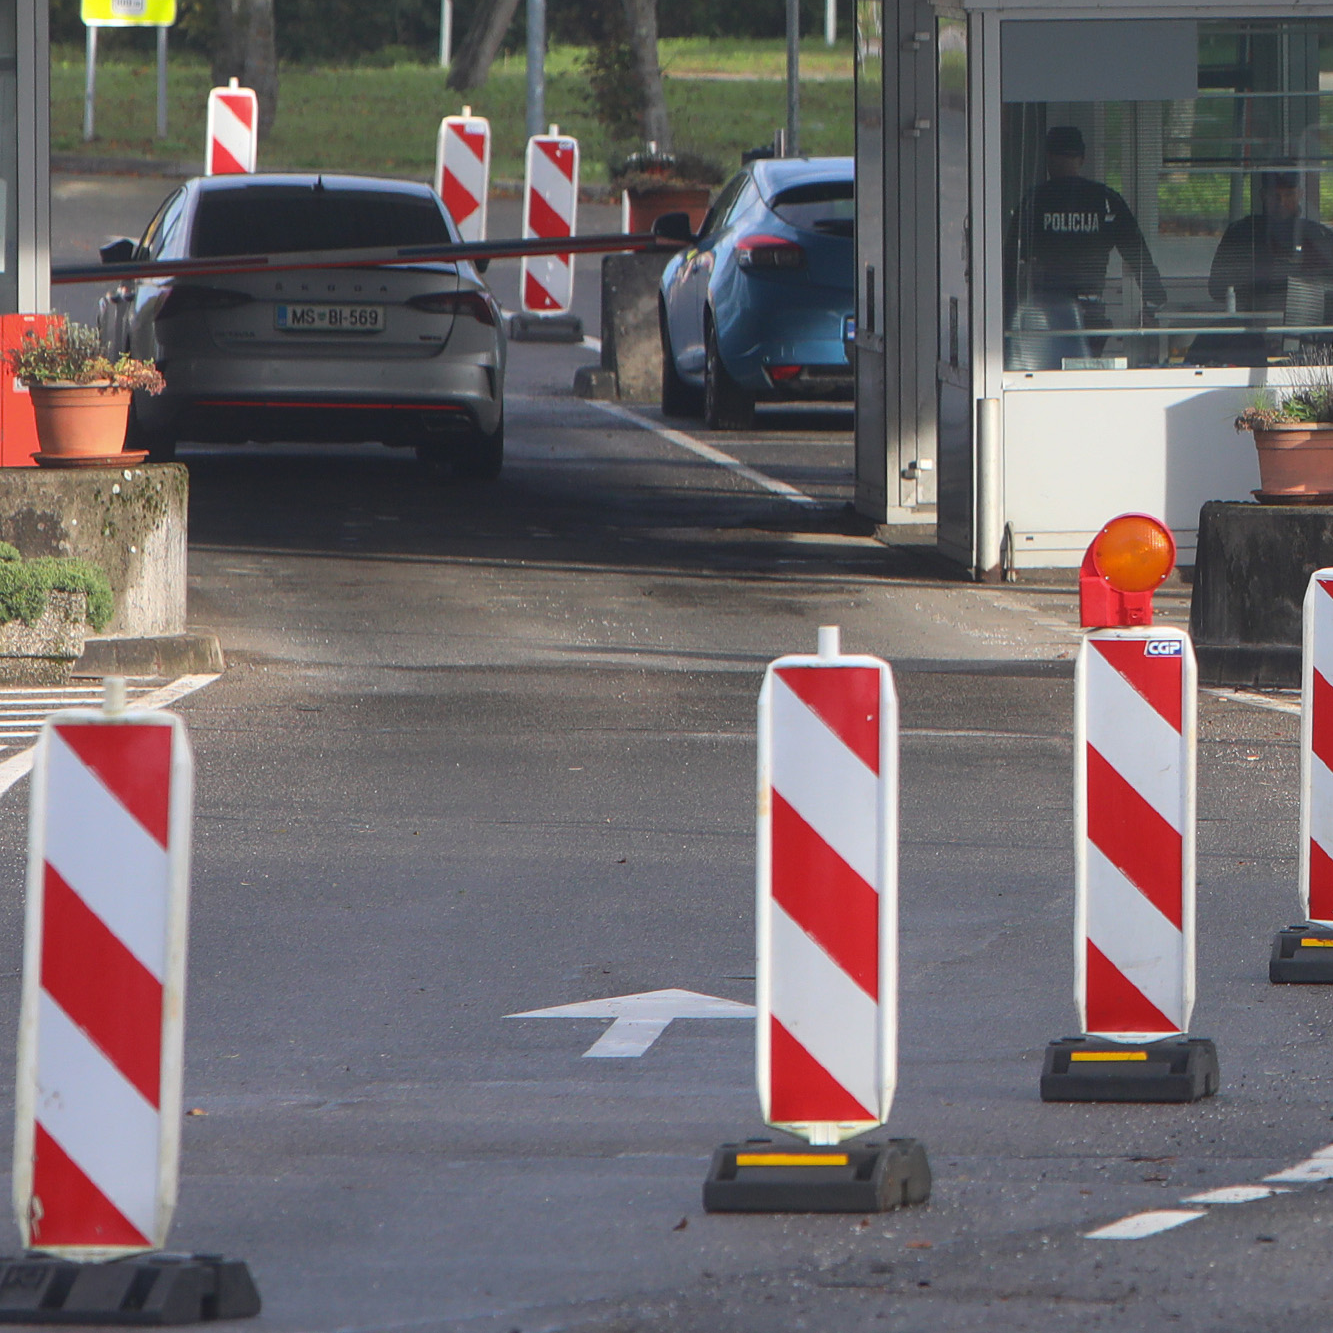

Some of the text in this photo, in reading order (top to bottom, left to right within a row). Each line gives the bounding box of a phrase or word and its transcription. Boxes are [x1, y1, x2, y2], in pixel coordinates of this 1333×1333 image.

[1043, 212, 1099, 231] POLICIJA
[292, 308, 378, 326] MS BI-569
[1148, 641, 1180, 655] CGP
